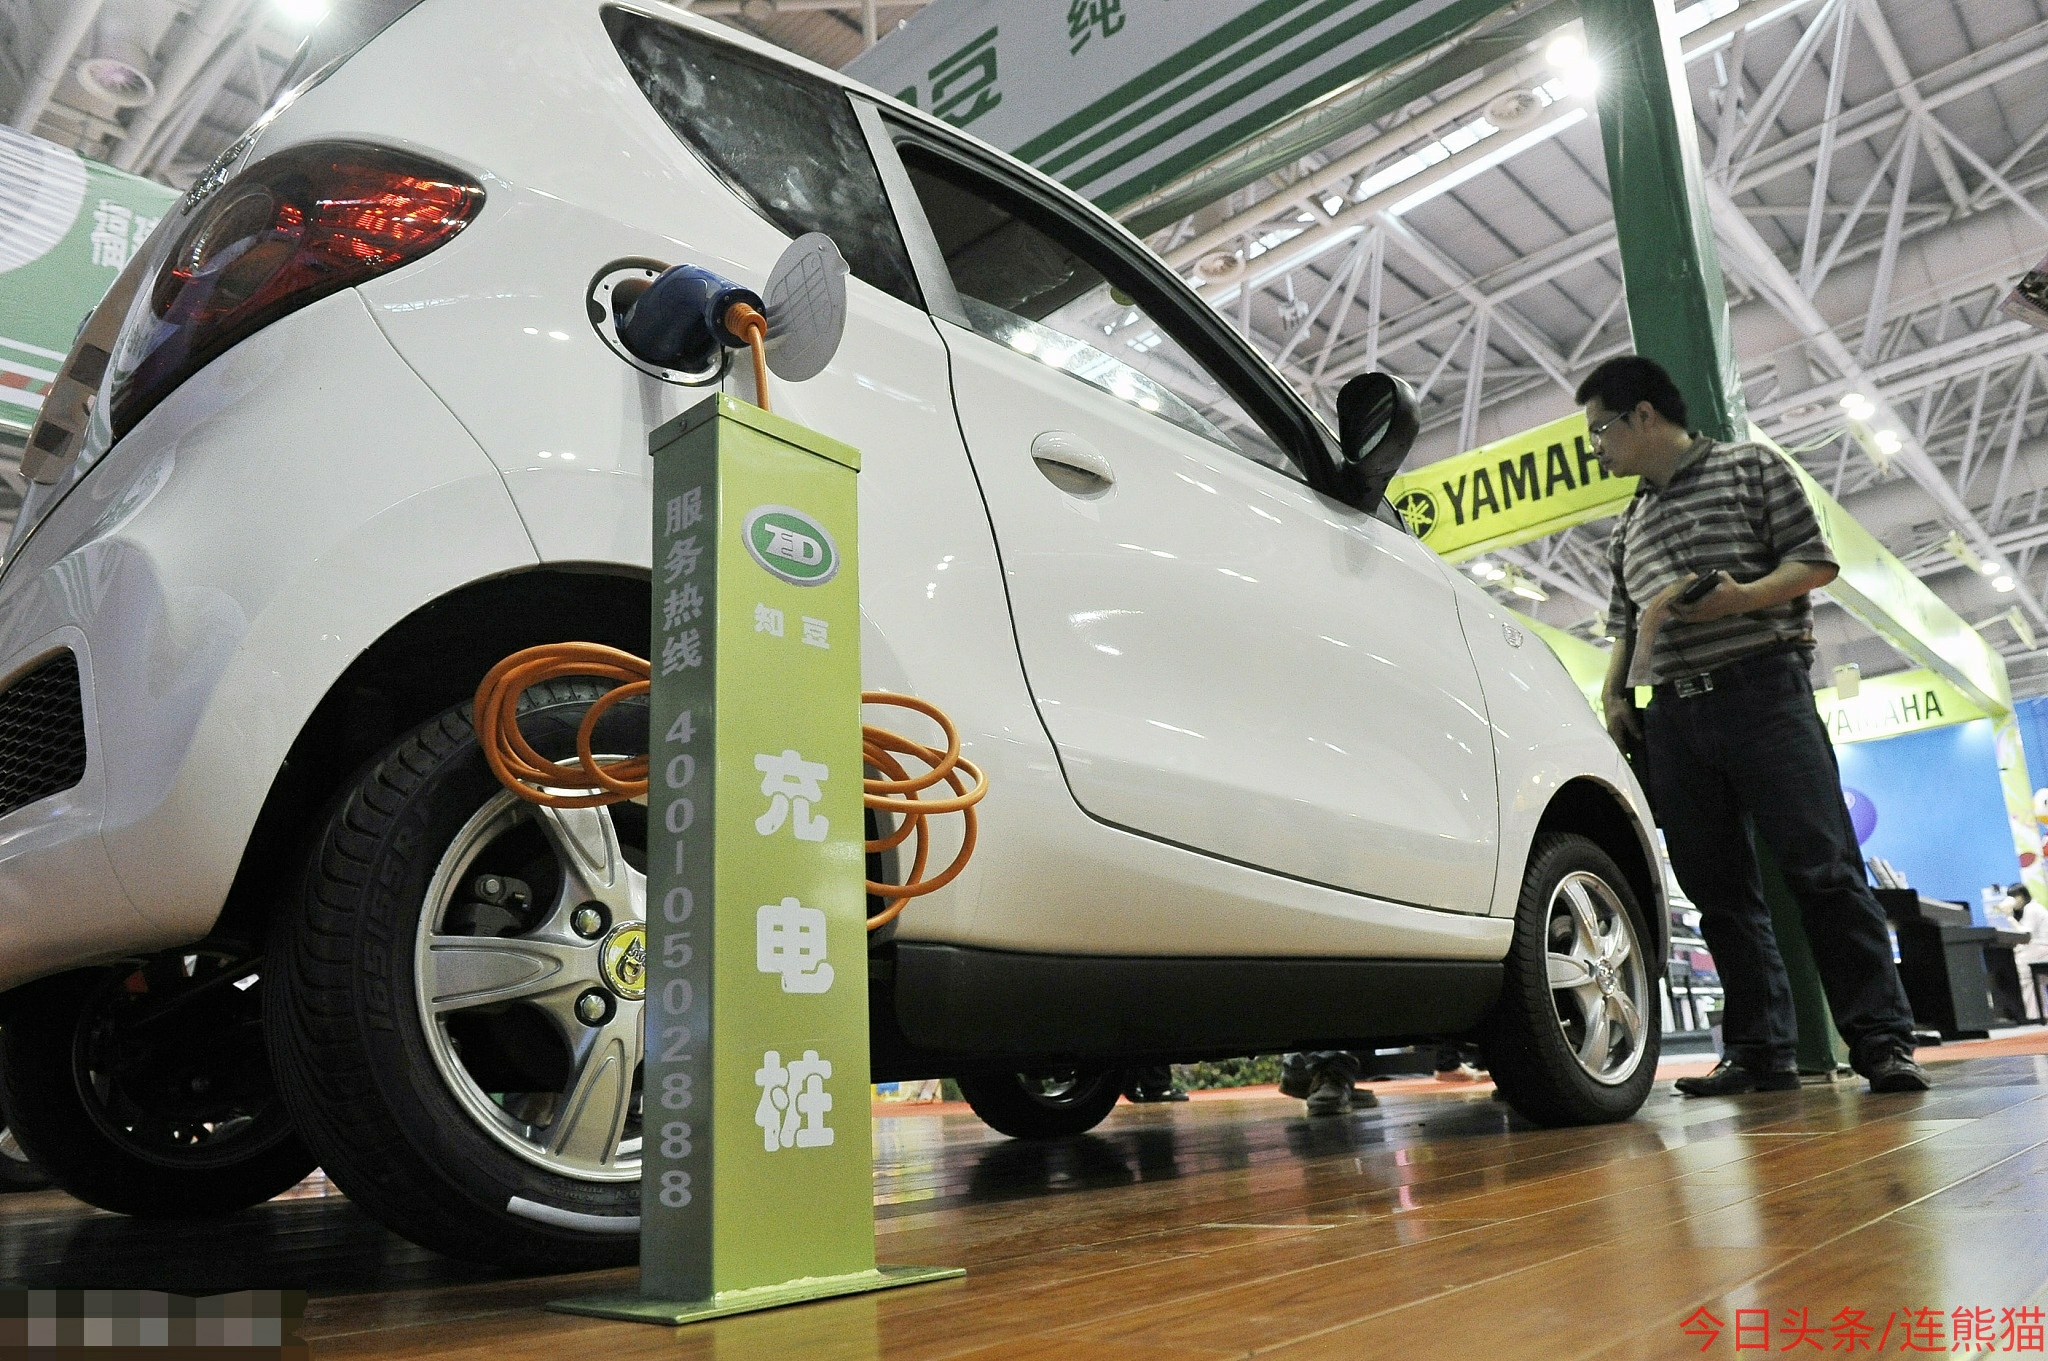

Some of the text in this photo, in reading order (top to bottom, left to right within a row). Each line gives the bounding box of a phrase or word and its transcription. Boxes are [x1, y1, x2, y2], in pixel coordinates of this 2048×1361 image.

[894, 25, 1002, 130] 豆
[661, 485, 704, 677] 服务热线
[753, 602, 830, 650] 知豆
[1824, 690, 1944, 737] YAAHA
[753, 749, 836, 1152] 充电桩
